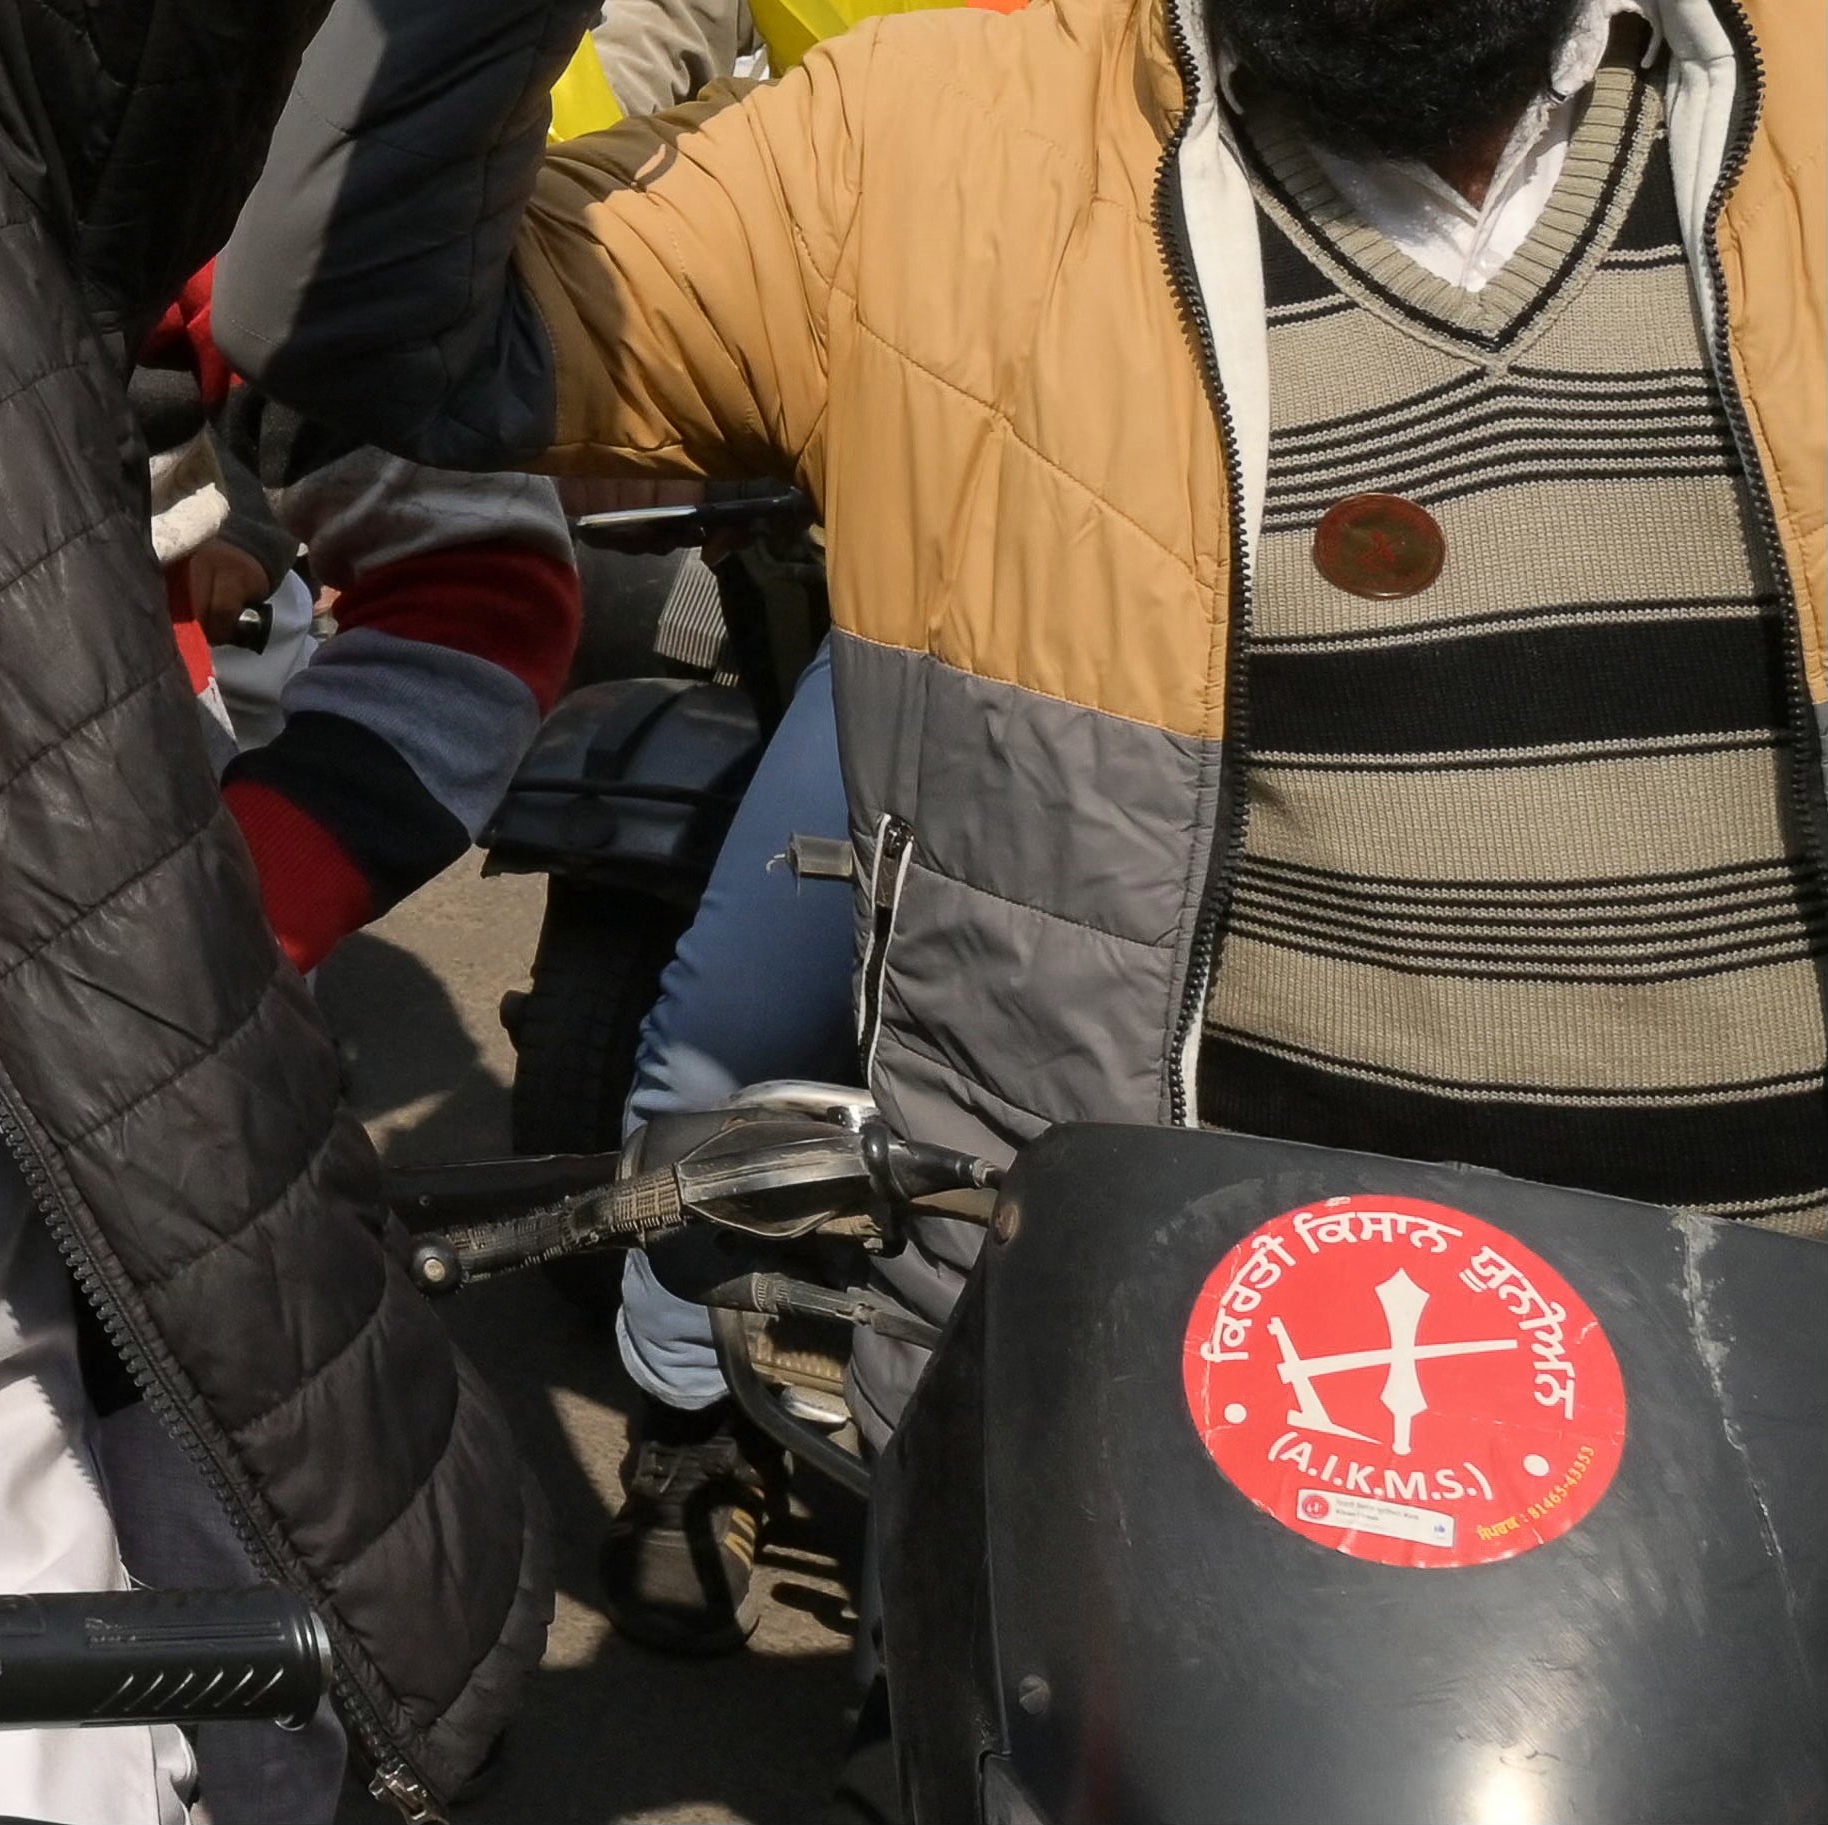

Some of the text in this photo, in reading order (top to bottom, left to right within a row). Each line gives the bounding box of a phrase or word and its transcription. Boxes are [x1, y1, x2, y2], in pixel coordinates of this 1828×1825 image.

[1200, 1211, 1577, 1421] ਕਿਰਤੀ ਕਿਸਾਨ ਯੂਨੀਅਨ
[1268, 1431, 1493, 1502] (A.I.K.M.S.)
